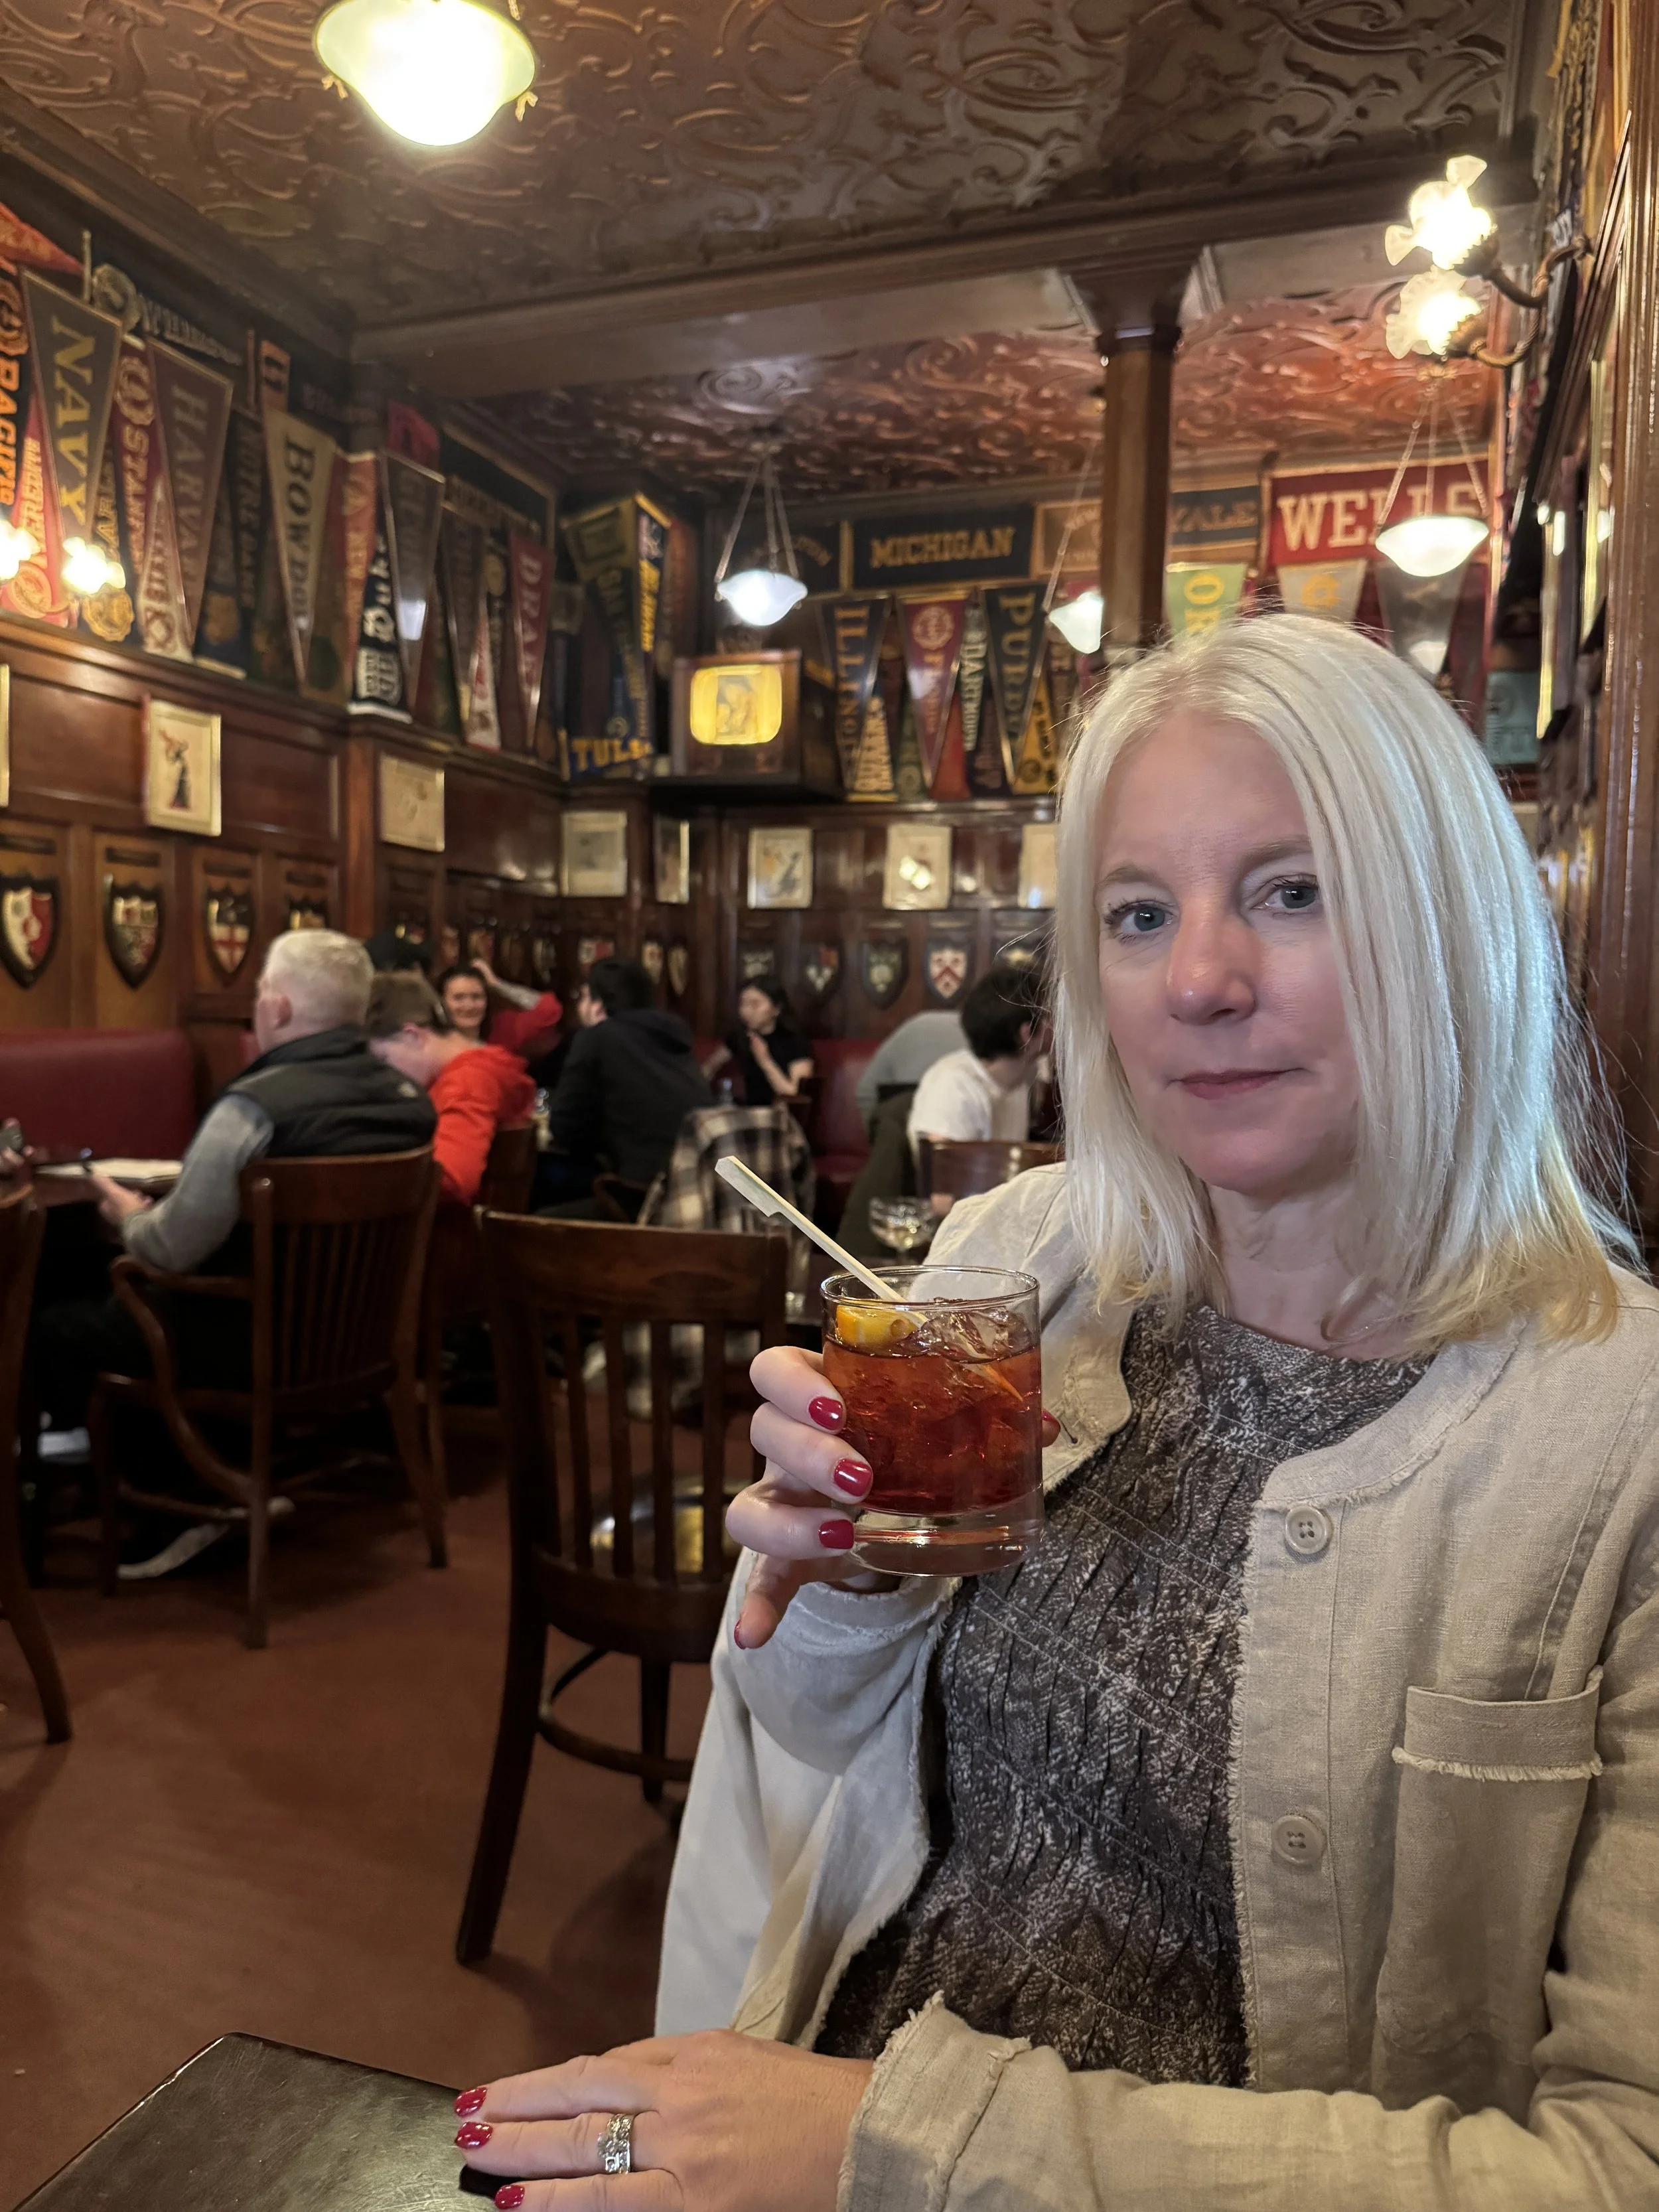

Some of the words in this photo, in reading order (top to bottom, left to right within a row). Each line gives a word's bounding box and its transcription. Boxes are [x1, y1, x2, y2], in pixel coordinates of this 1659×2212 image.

[51, 315, 97, 526] NAVY
[1170, 500, 1257, 532] YALE
[870, 526, 1016, 568] MICHIGAN
